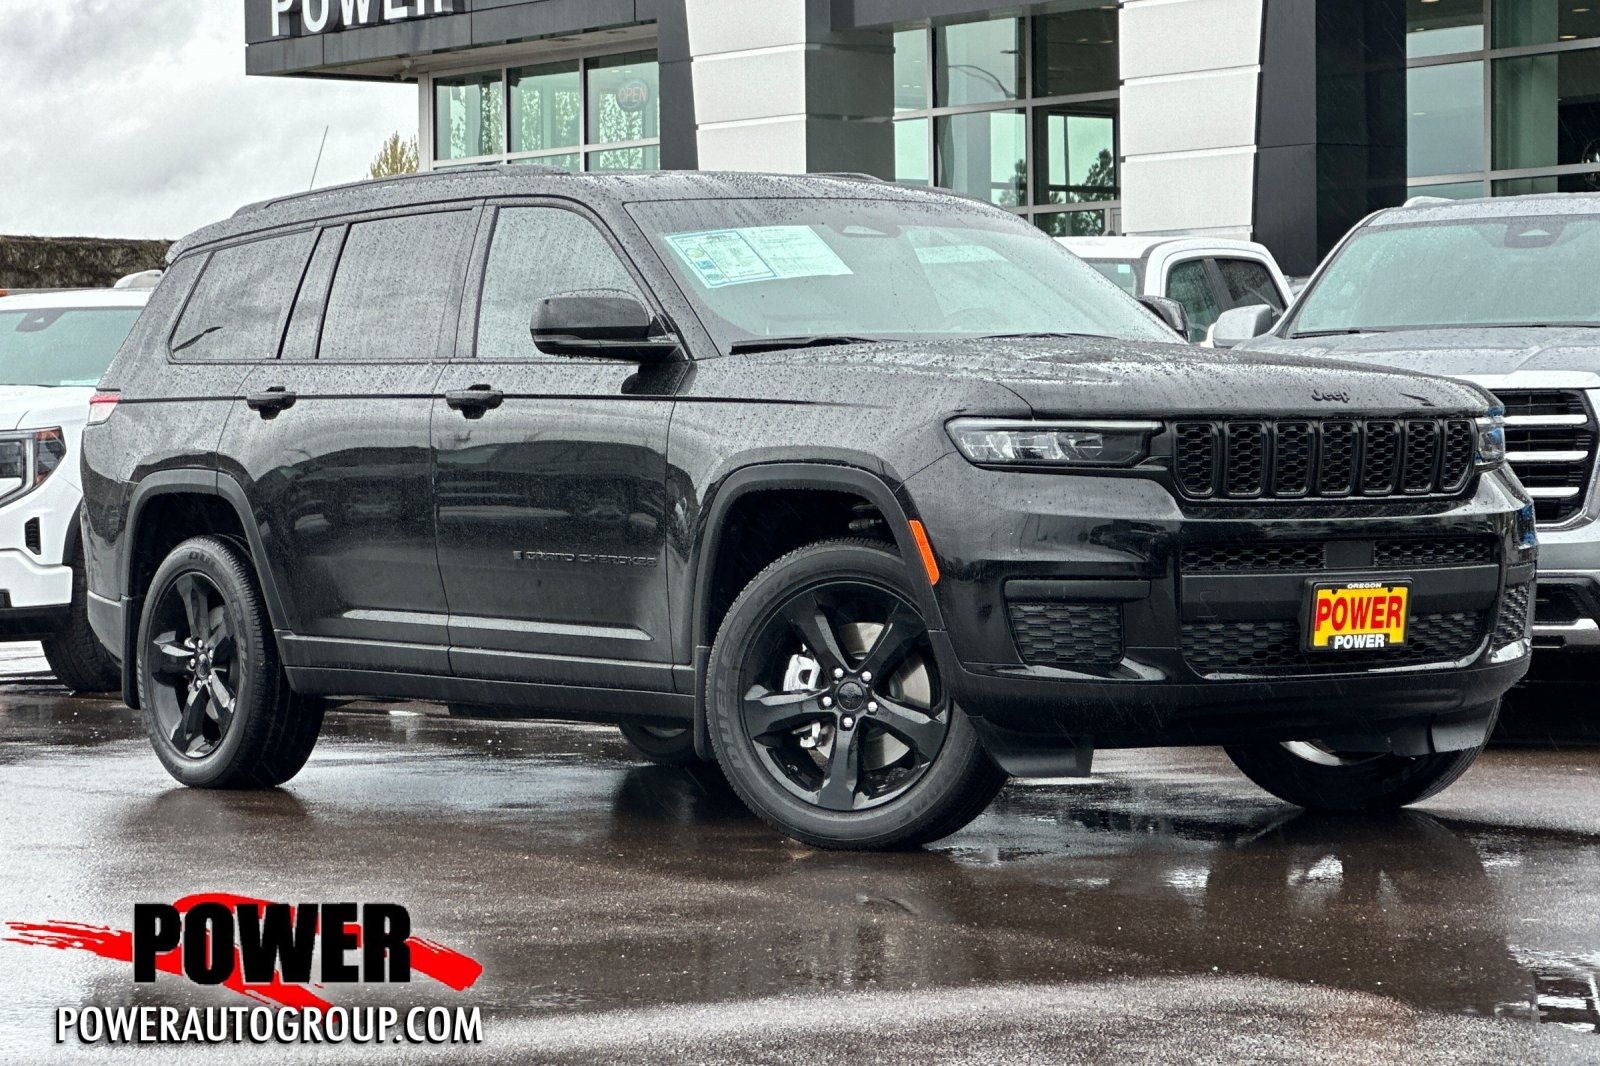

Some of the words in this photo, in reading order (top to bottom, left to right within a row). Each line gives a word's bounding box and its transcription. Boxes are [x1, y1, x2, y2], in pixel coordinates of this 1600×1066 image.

[1311, 389, 1350, 404] Jeep
[1346, 582, 1382, 590] OREGON
[1314, 595, 1403, 632] POWER
[1334, 633, 1385, 650] POWER
